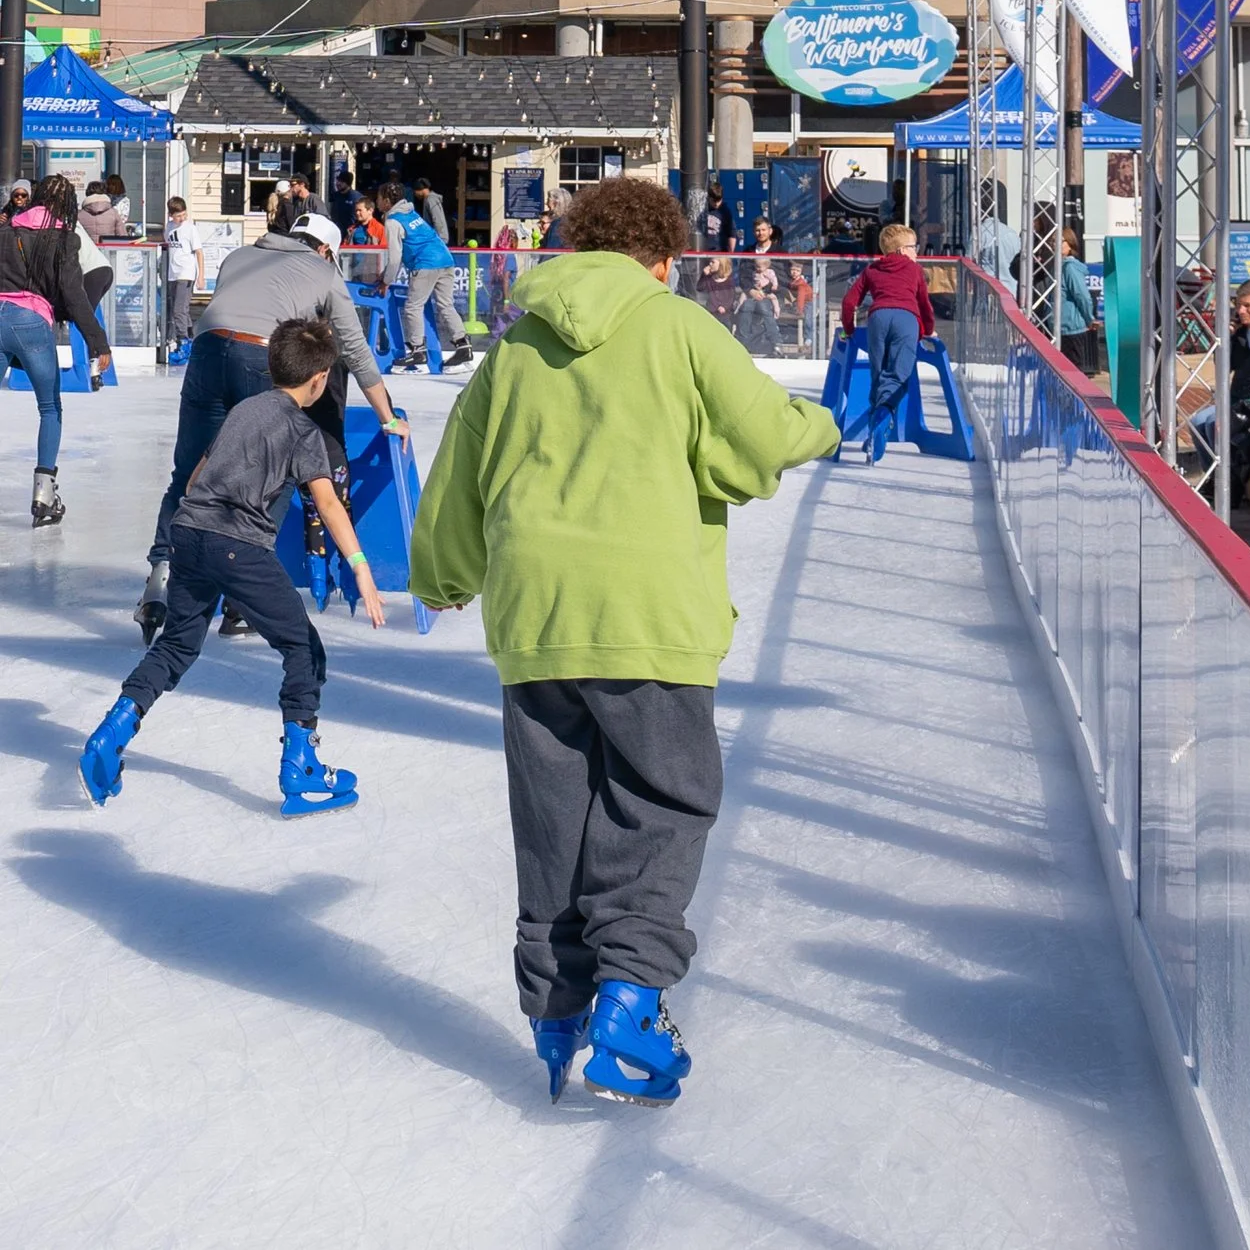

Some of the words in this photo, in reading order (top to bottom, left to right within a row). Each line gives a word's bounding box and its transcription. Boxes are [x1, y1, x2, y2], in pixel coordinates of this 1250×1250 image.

[832, 4, 871, 12] WELCOME
[873, 4, 884, 12] TO
[784, 12, 907, 45] Baltimore's
[802, 32, 933, 67] Waterfront
[594, 1028, 600, 1040] 8
[552, 1048, 559, 1059] 8
